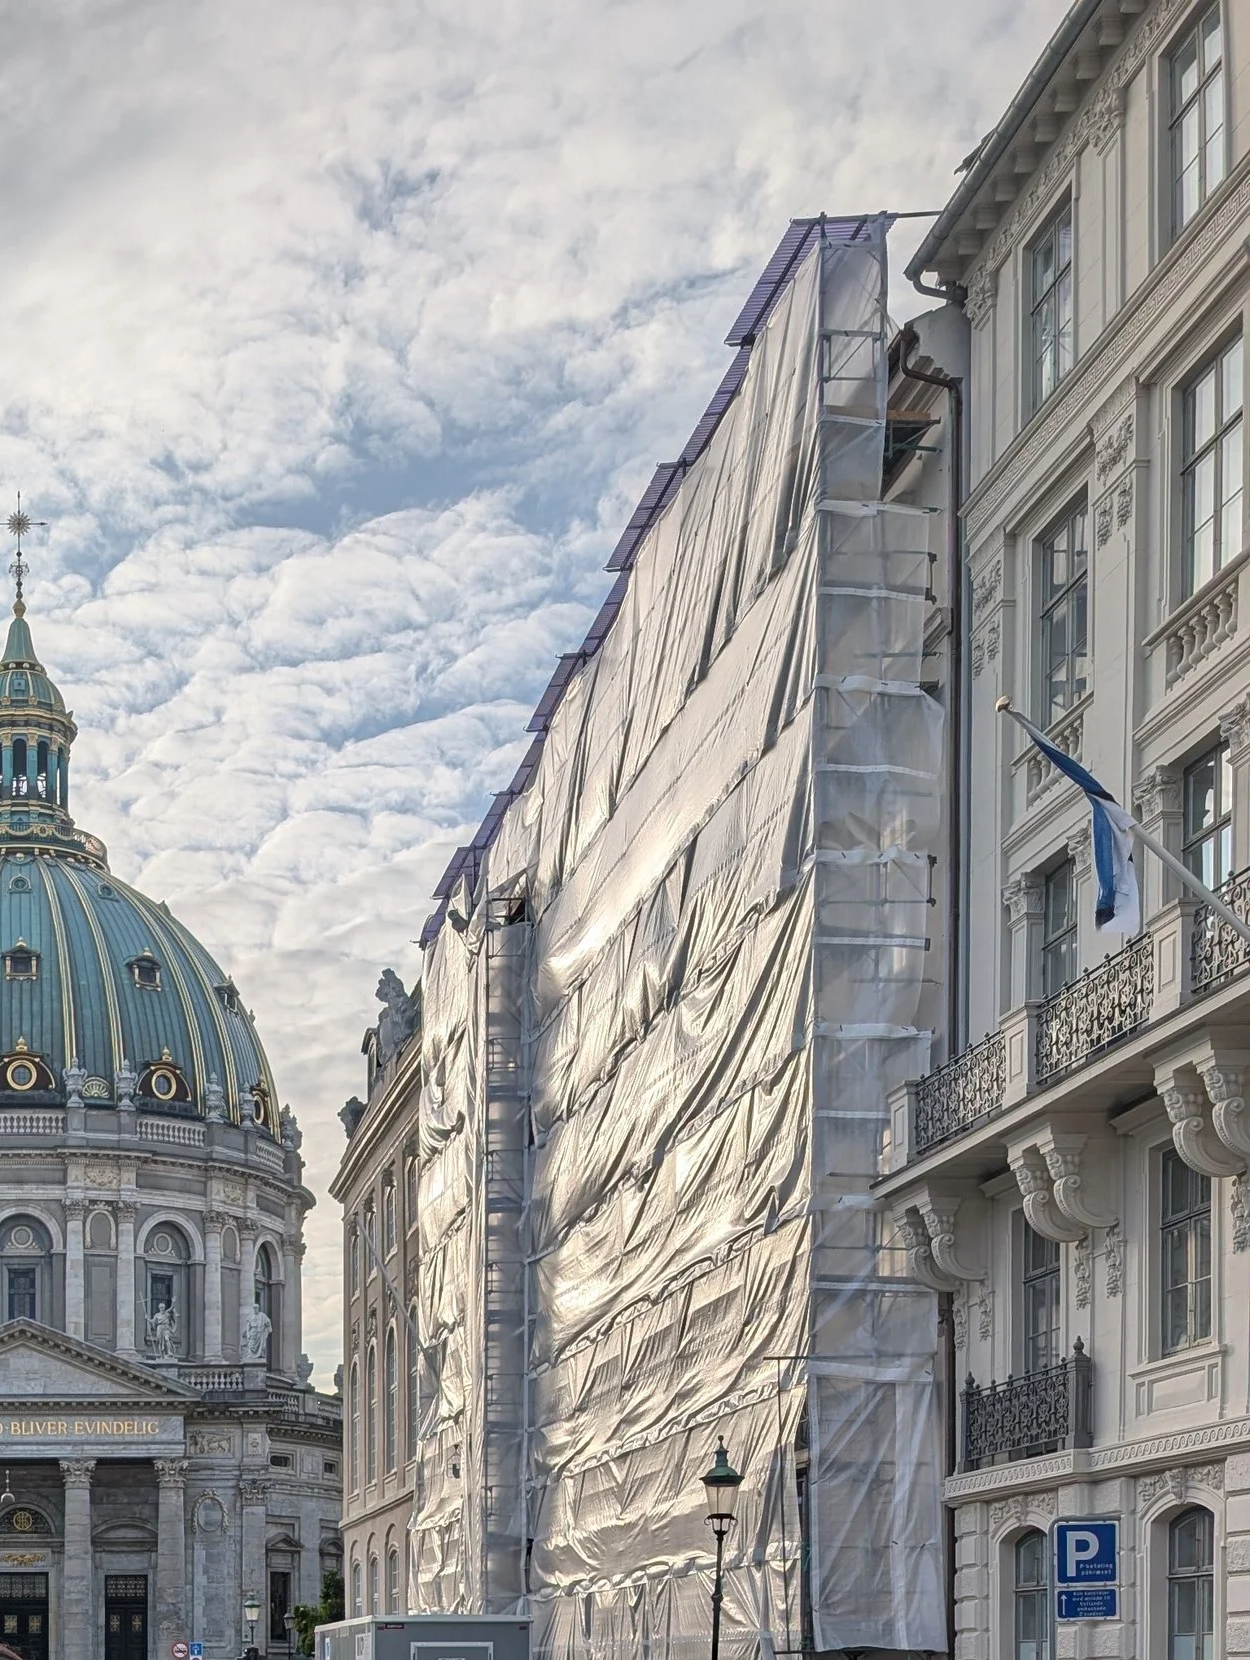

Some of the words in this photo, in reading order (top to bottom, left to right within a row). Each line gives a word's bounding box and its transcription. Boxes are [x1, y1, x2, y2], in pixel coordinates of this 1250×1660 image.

[10, 1421, 68, 1435] BLIVER
[74, 1421, 159, 1435] EVINDELIG
[1066, 1531, 1099, 1577] P
